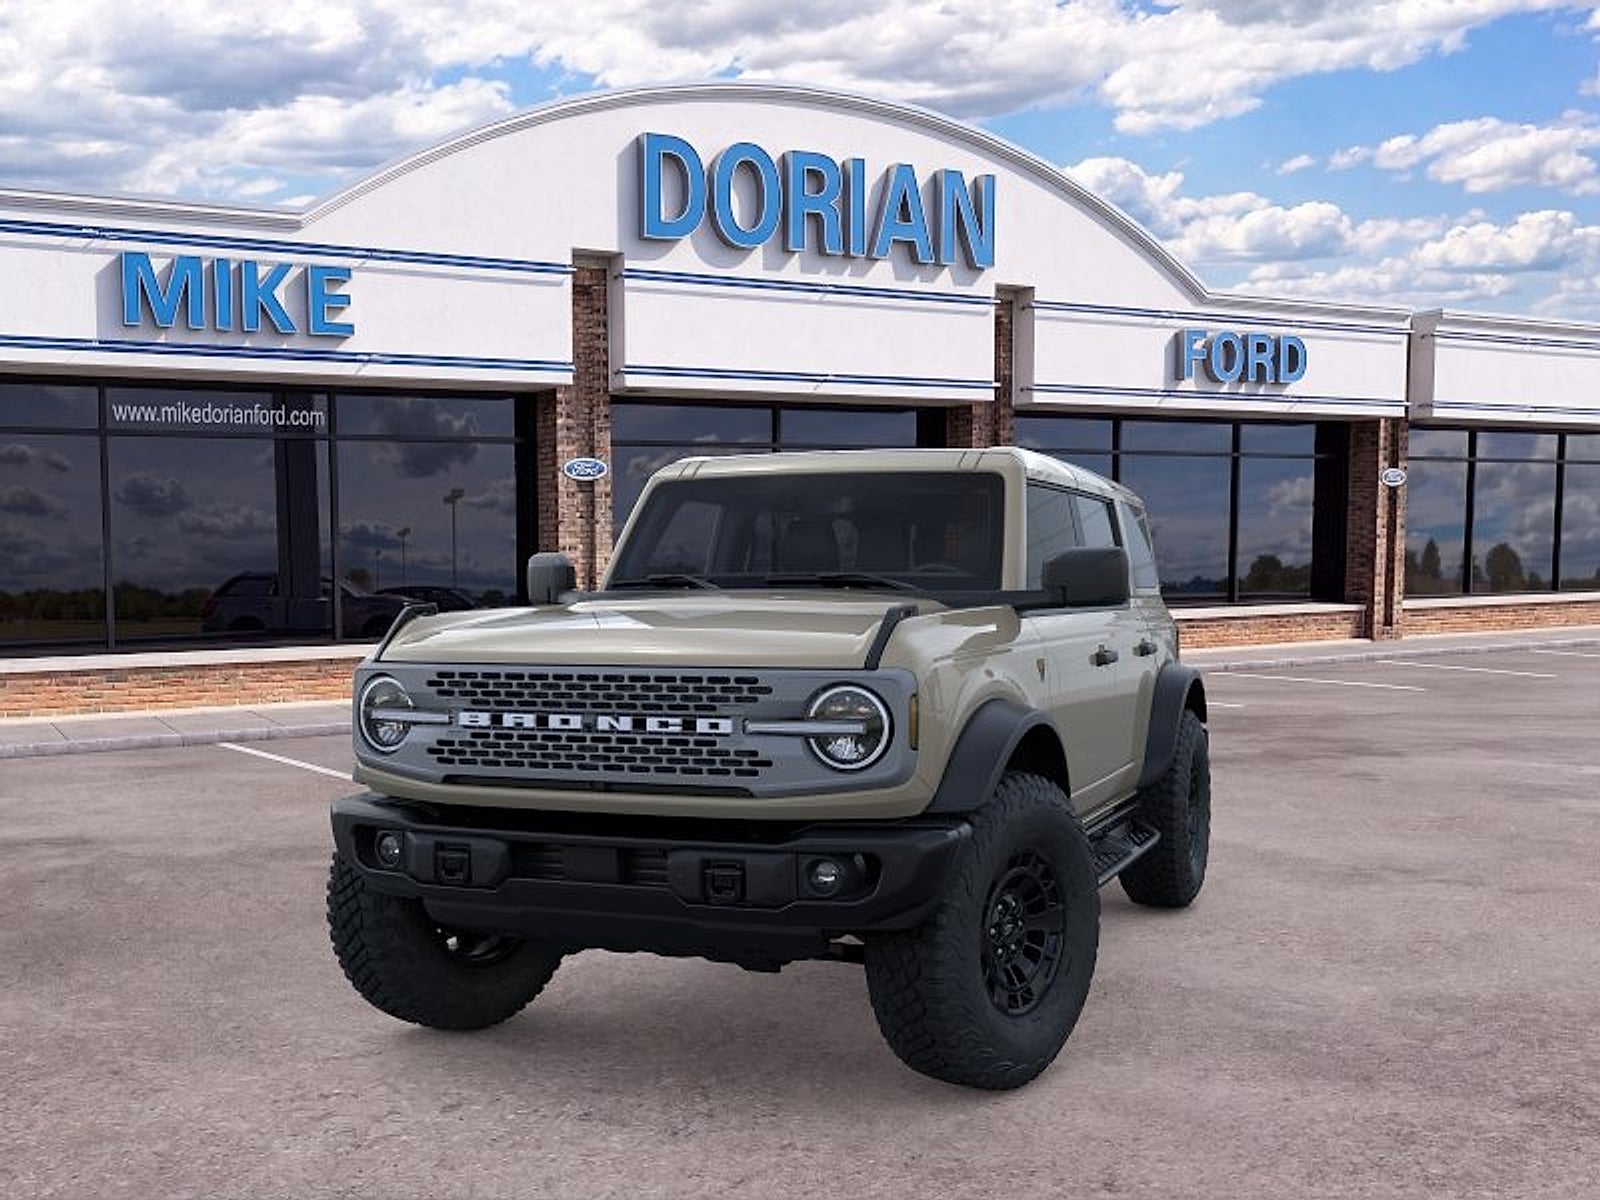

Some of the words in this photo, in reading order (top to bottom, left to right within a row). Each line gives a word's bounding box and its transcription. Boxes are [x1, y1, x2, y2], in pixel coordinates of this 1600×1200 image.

[641, 132, 996, 270] DORIAN
[121, 251, 355, 337] MIKE
[1178, 328, 1308, 383] FORD
[112, 402, 325, 426] www.mikedorianford.com
[458, 711, 732, 734] BRONCO
